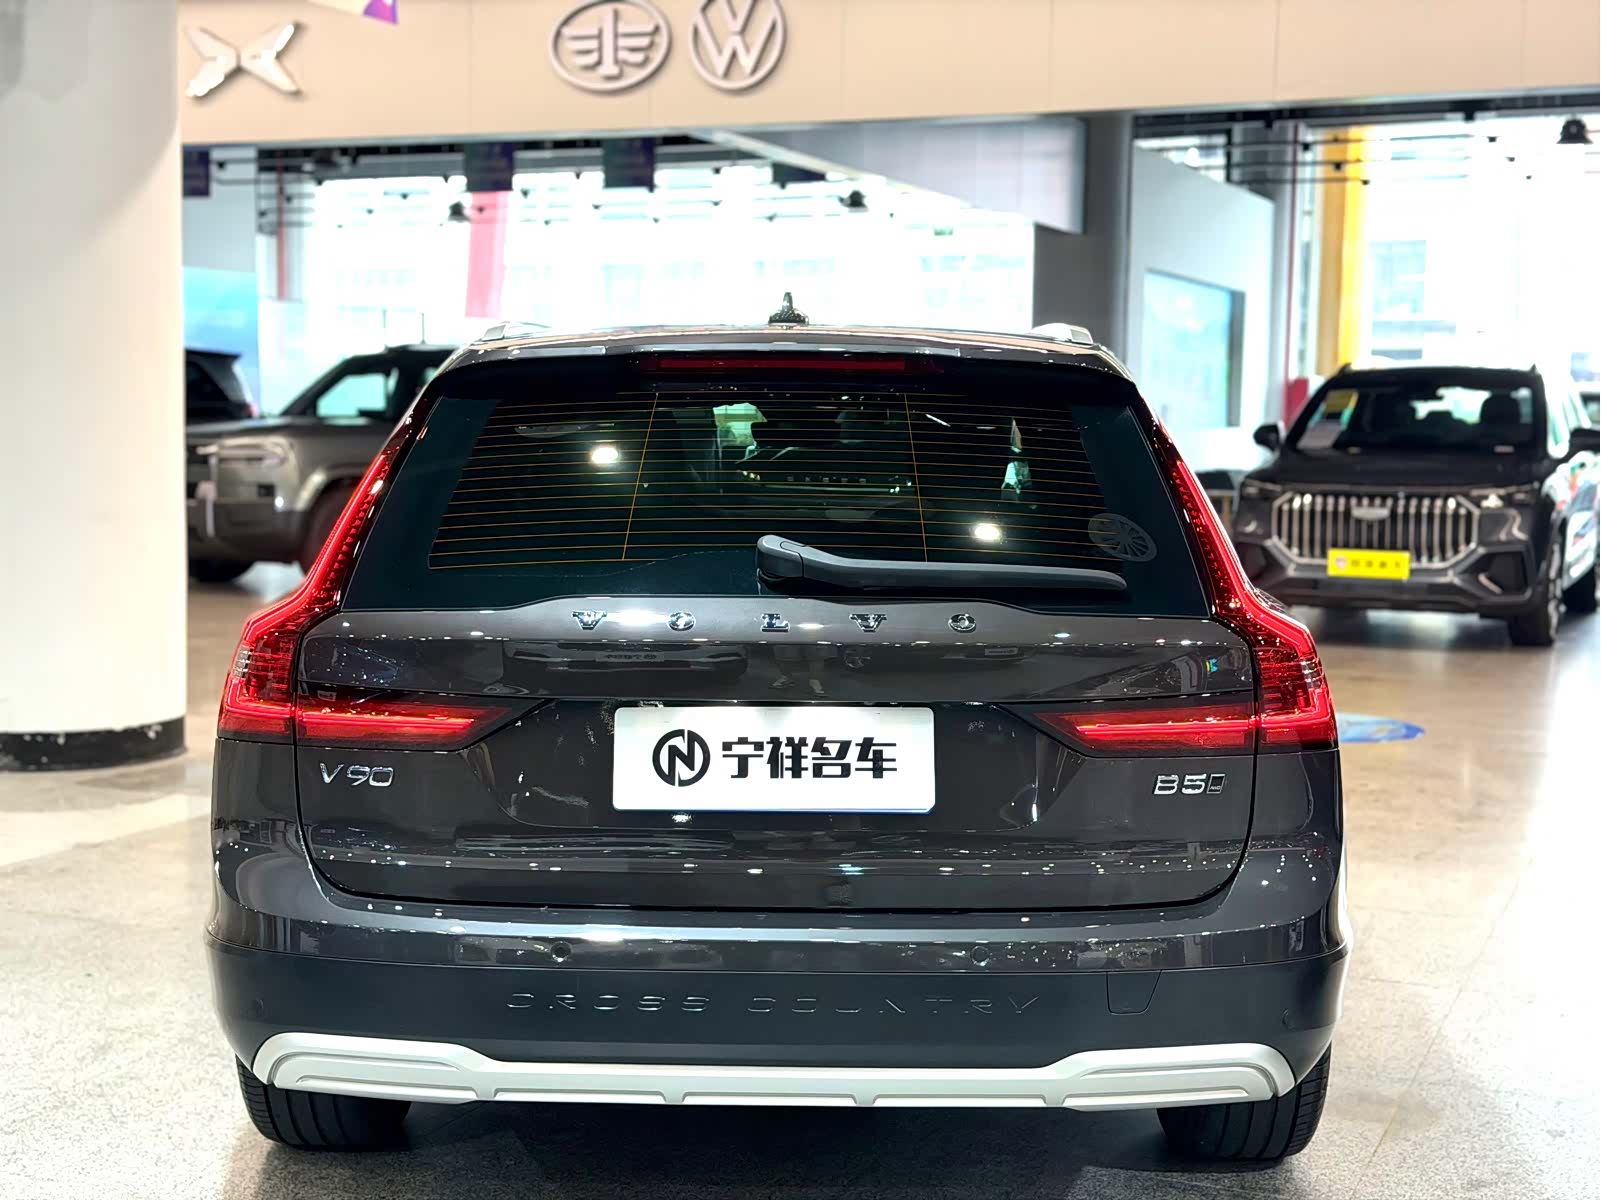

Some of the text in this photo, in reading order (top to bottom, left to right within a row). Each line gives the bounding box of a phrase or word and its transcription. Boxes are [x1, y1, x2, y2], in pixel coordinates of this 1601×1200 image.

[571, 610, 978, 633] VOLVO
[721, 736, 898, 779] 宁祥名车
[319, 762, 394, 787] V90
[1154, 773, 1207, 794] B5
[506, 993, 1039, 1014] CROSS COUNTRY
